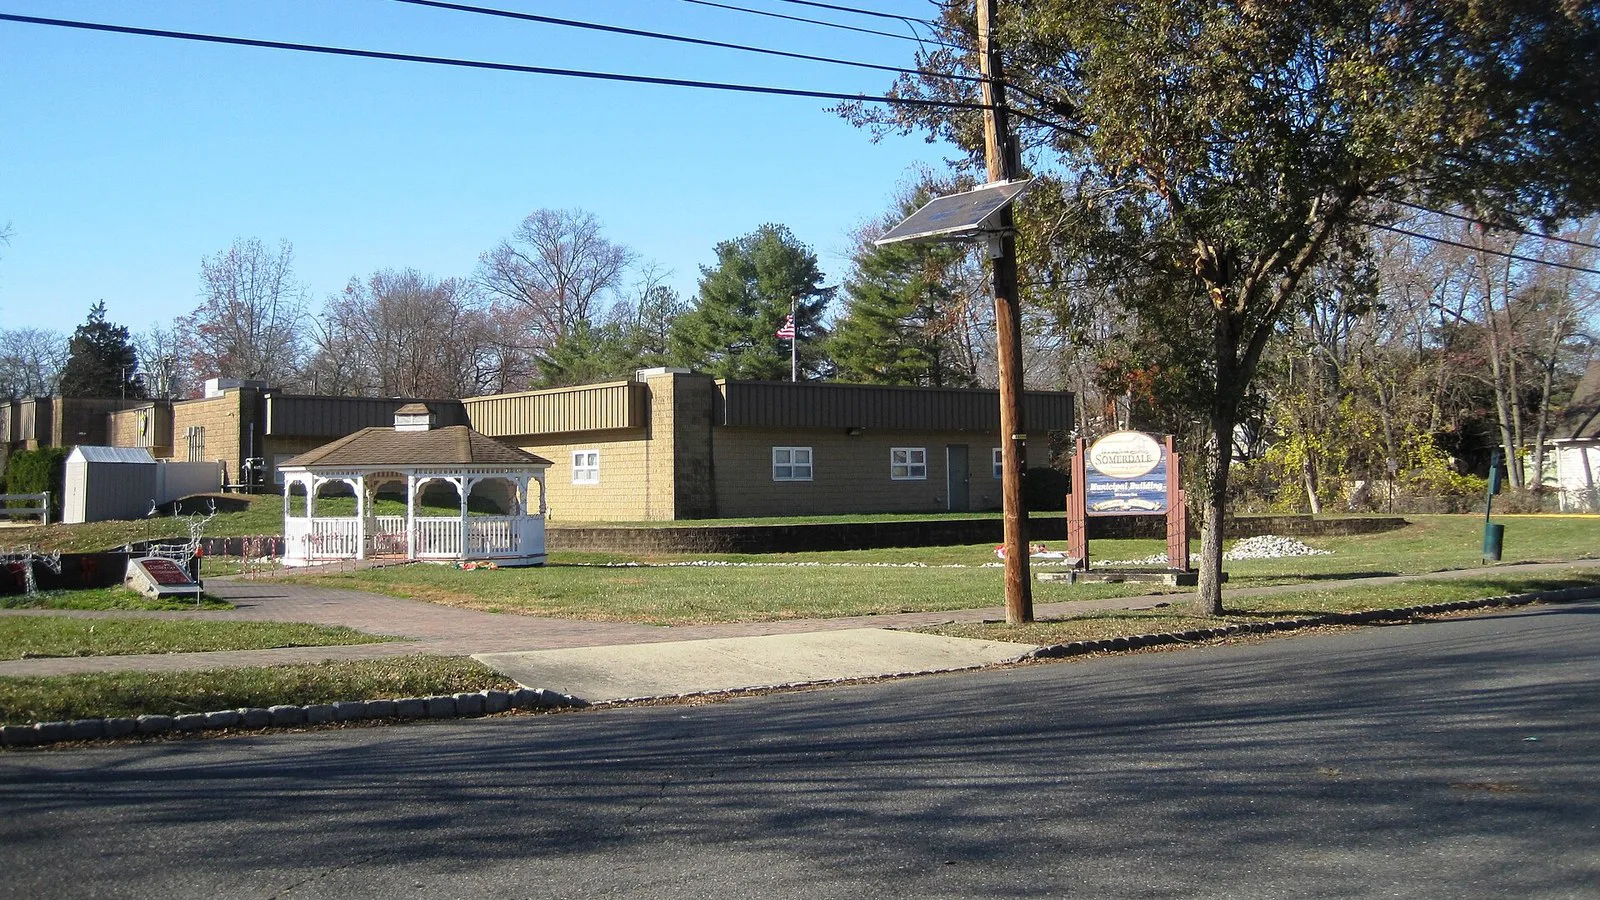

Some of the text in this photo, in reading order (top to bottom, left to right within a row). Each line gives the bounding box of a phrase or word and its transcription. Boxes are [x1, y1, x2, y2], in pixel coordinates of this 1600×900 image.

[1095, 454, 1152, 465] SOMERDALE
[1090, 481, 1163, 492] Municipal Building
